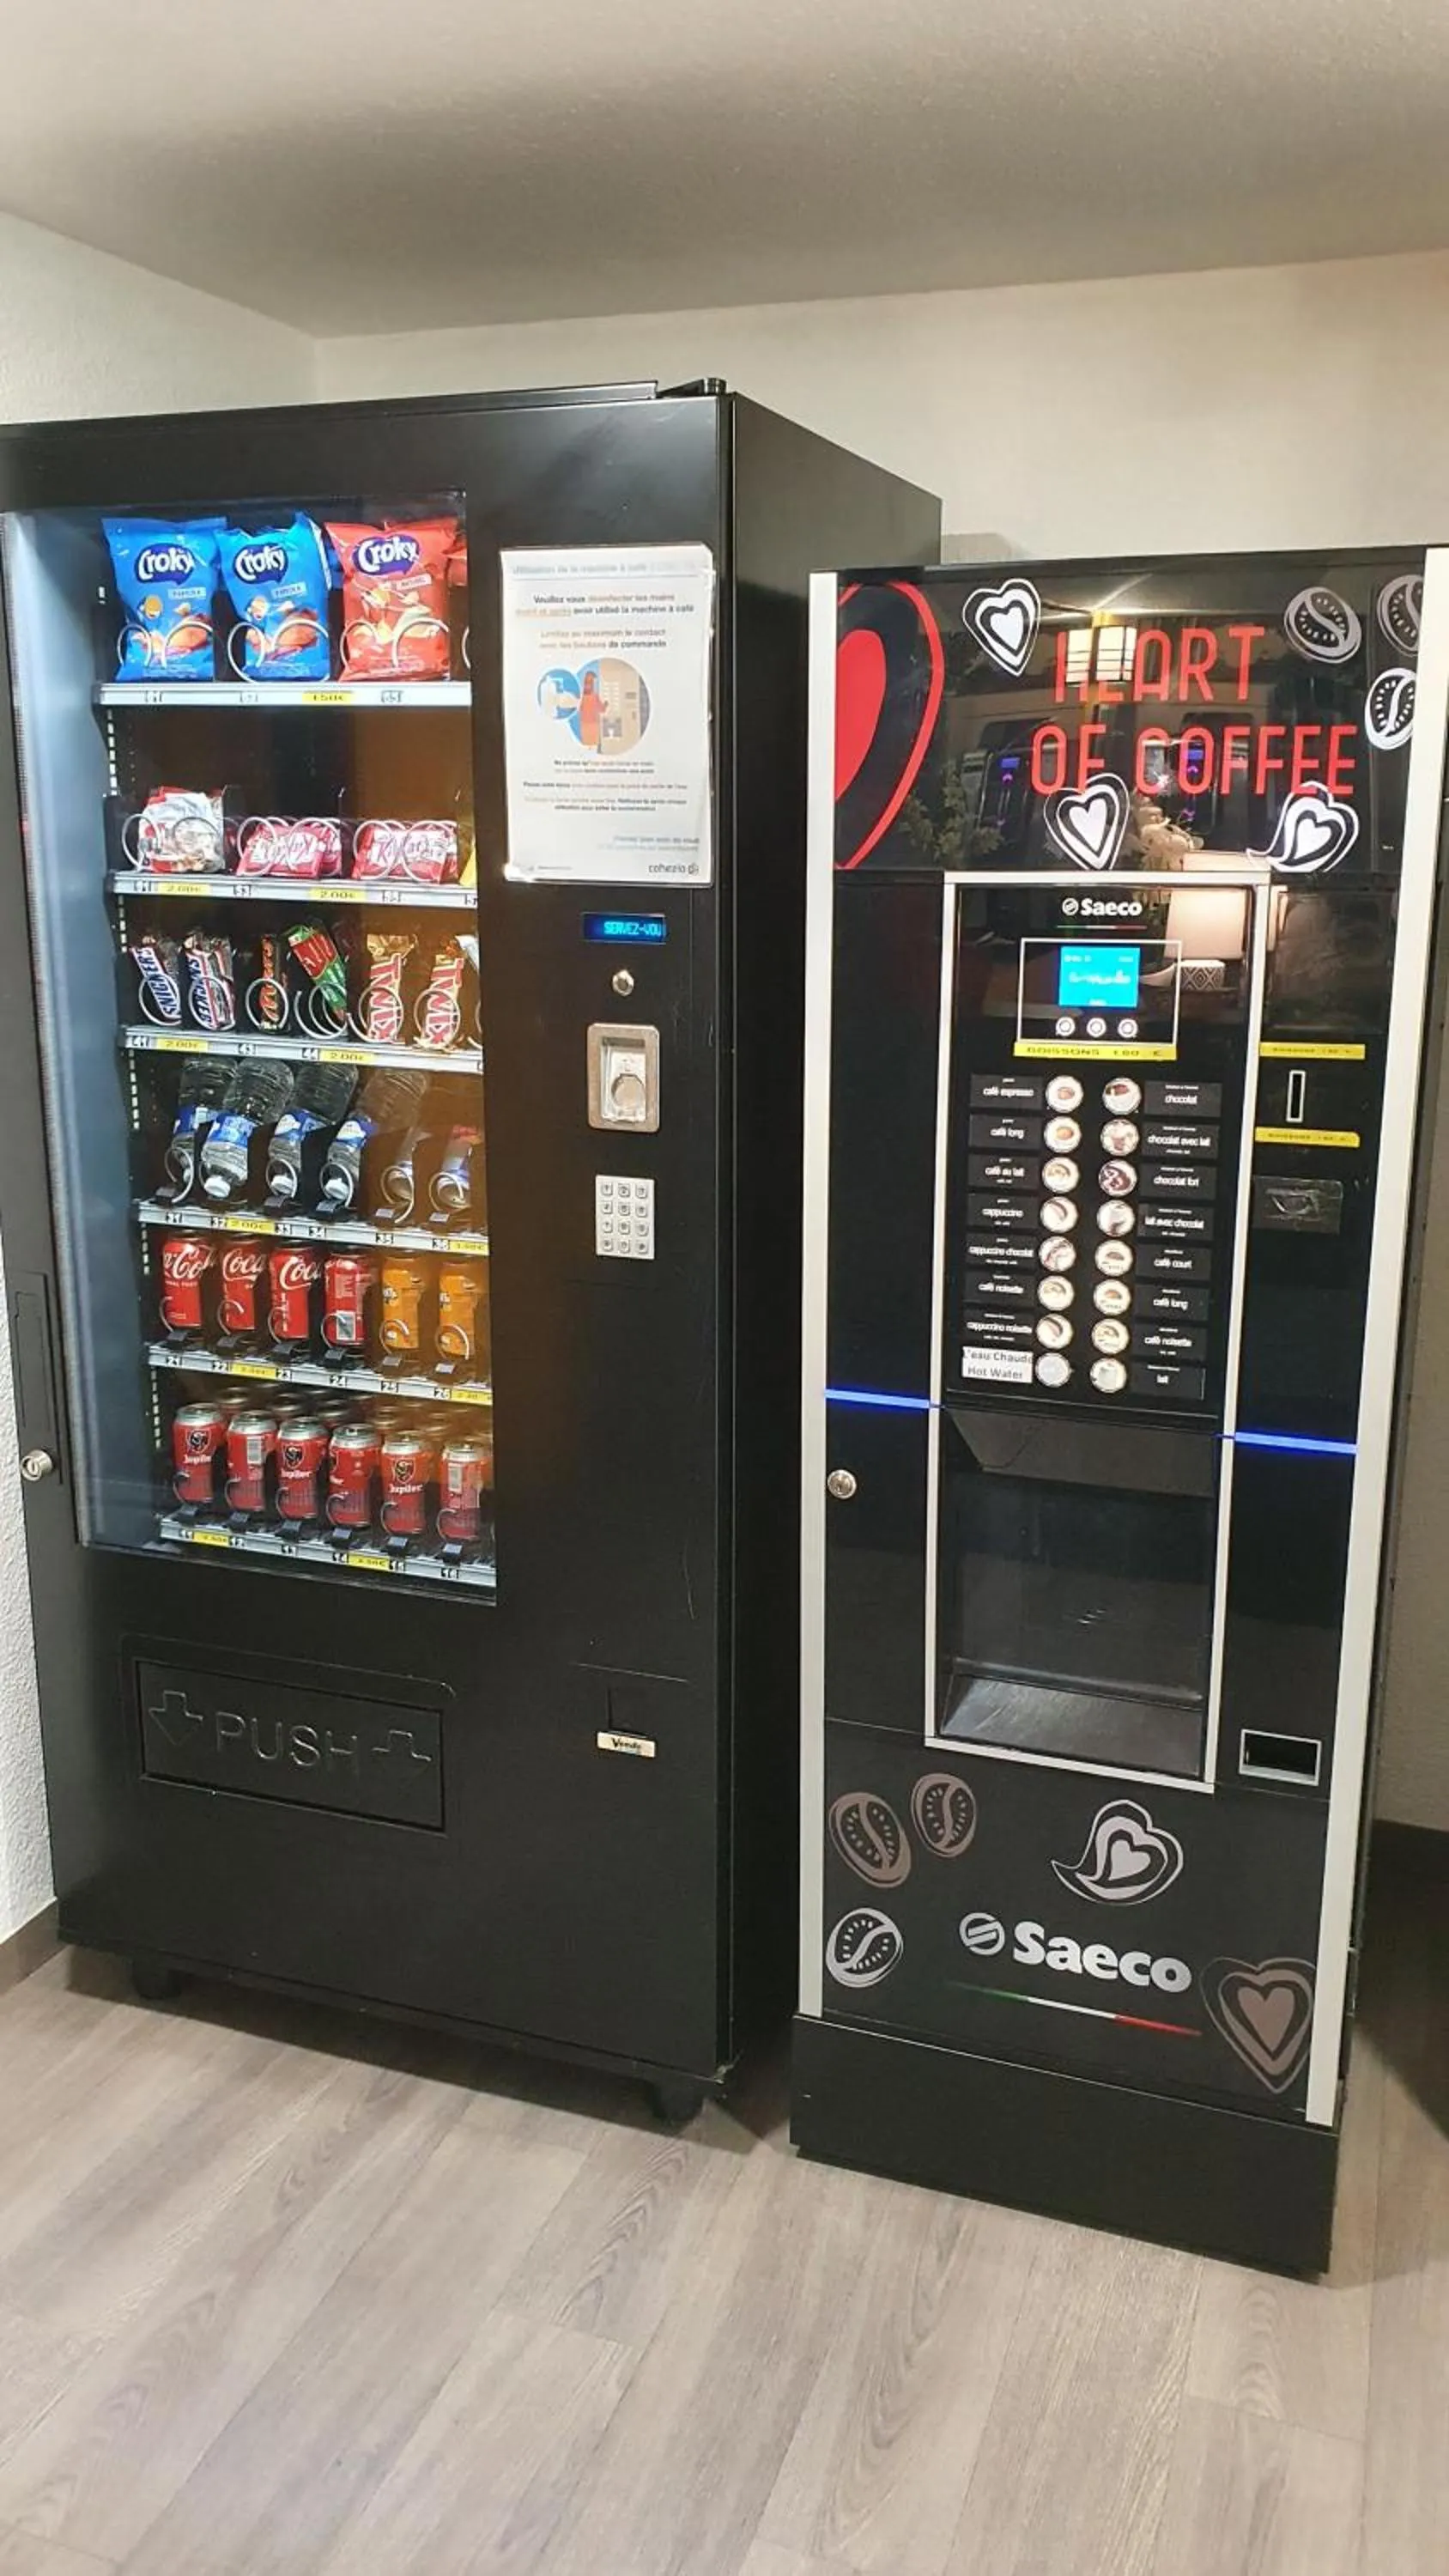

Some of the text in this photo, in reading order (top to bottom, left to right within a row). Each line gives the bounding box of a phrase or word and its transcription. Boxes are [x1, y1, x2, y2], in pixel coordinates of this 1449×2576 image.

[138, 548, 195, 581] Croky
[234, 545, 286, 581] Croky
[358, 536, 420, 573] Croky
[1056, 625, 1265, 703] HART
[1031, 723, 1358, 796] OF COFFEE
[1081, 897, 1143, 916] Saeco
[135, 947, 179, 1016] SNICKERS
[369, 953, 402, 1042] TWIX
[425, 957, 464, 1045] TWIX
[213, 1217, 227, 1228] 32
[276, 1224, 292, 1235] 33
[310, 1226, 325, 1237] 34
[967, 1367, 1023, 1379] Hot Water
[216, 1710, 361, 1776] PUSH
[1013, 1920, 1192, 1994] Saeco
